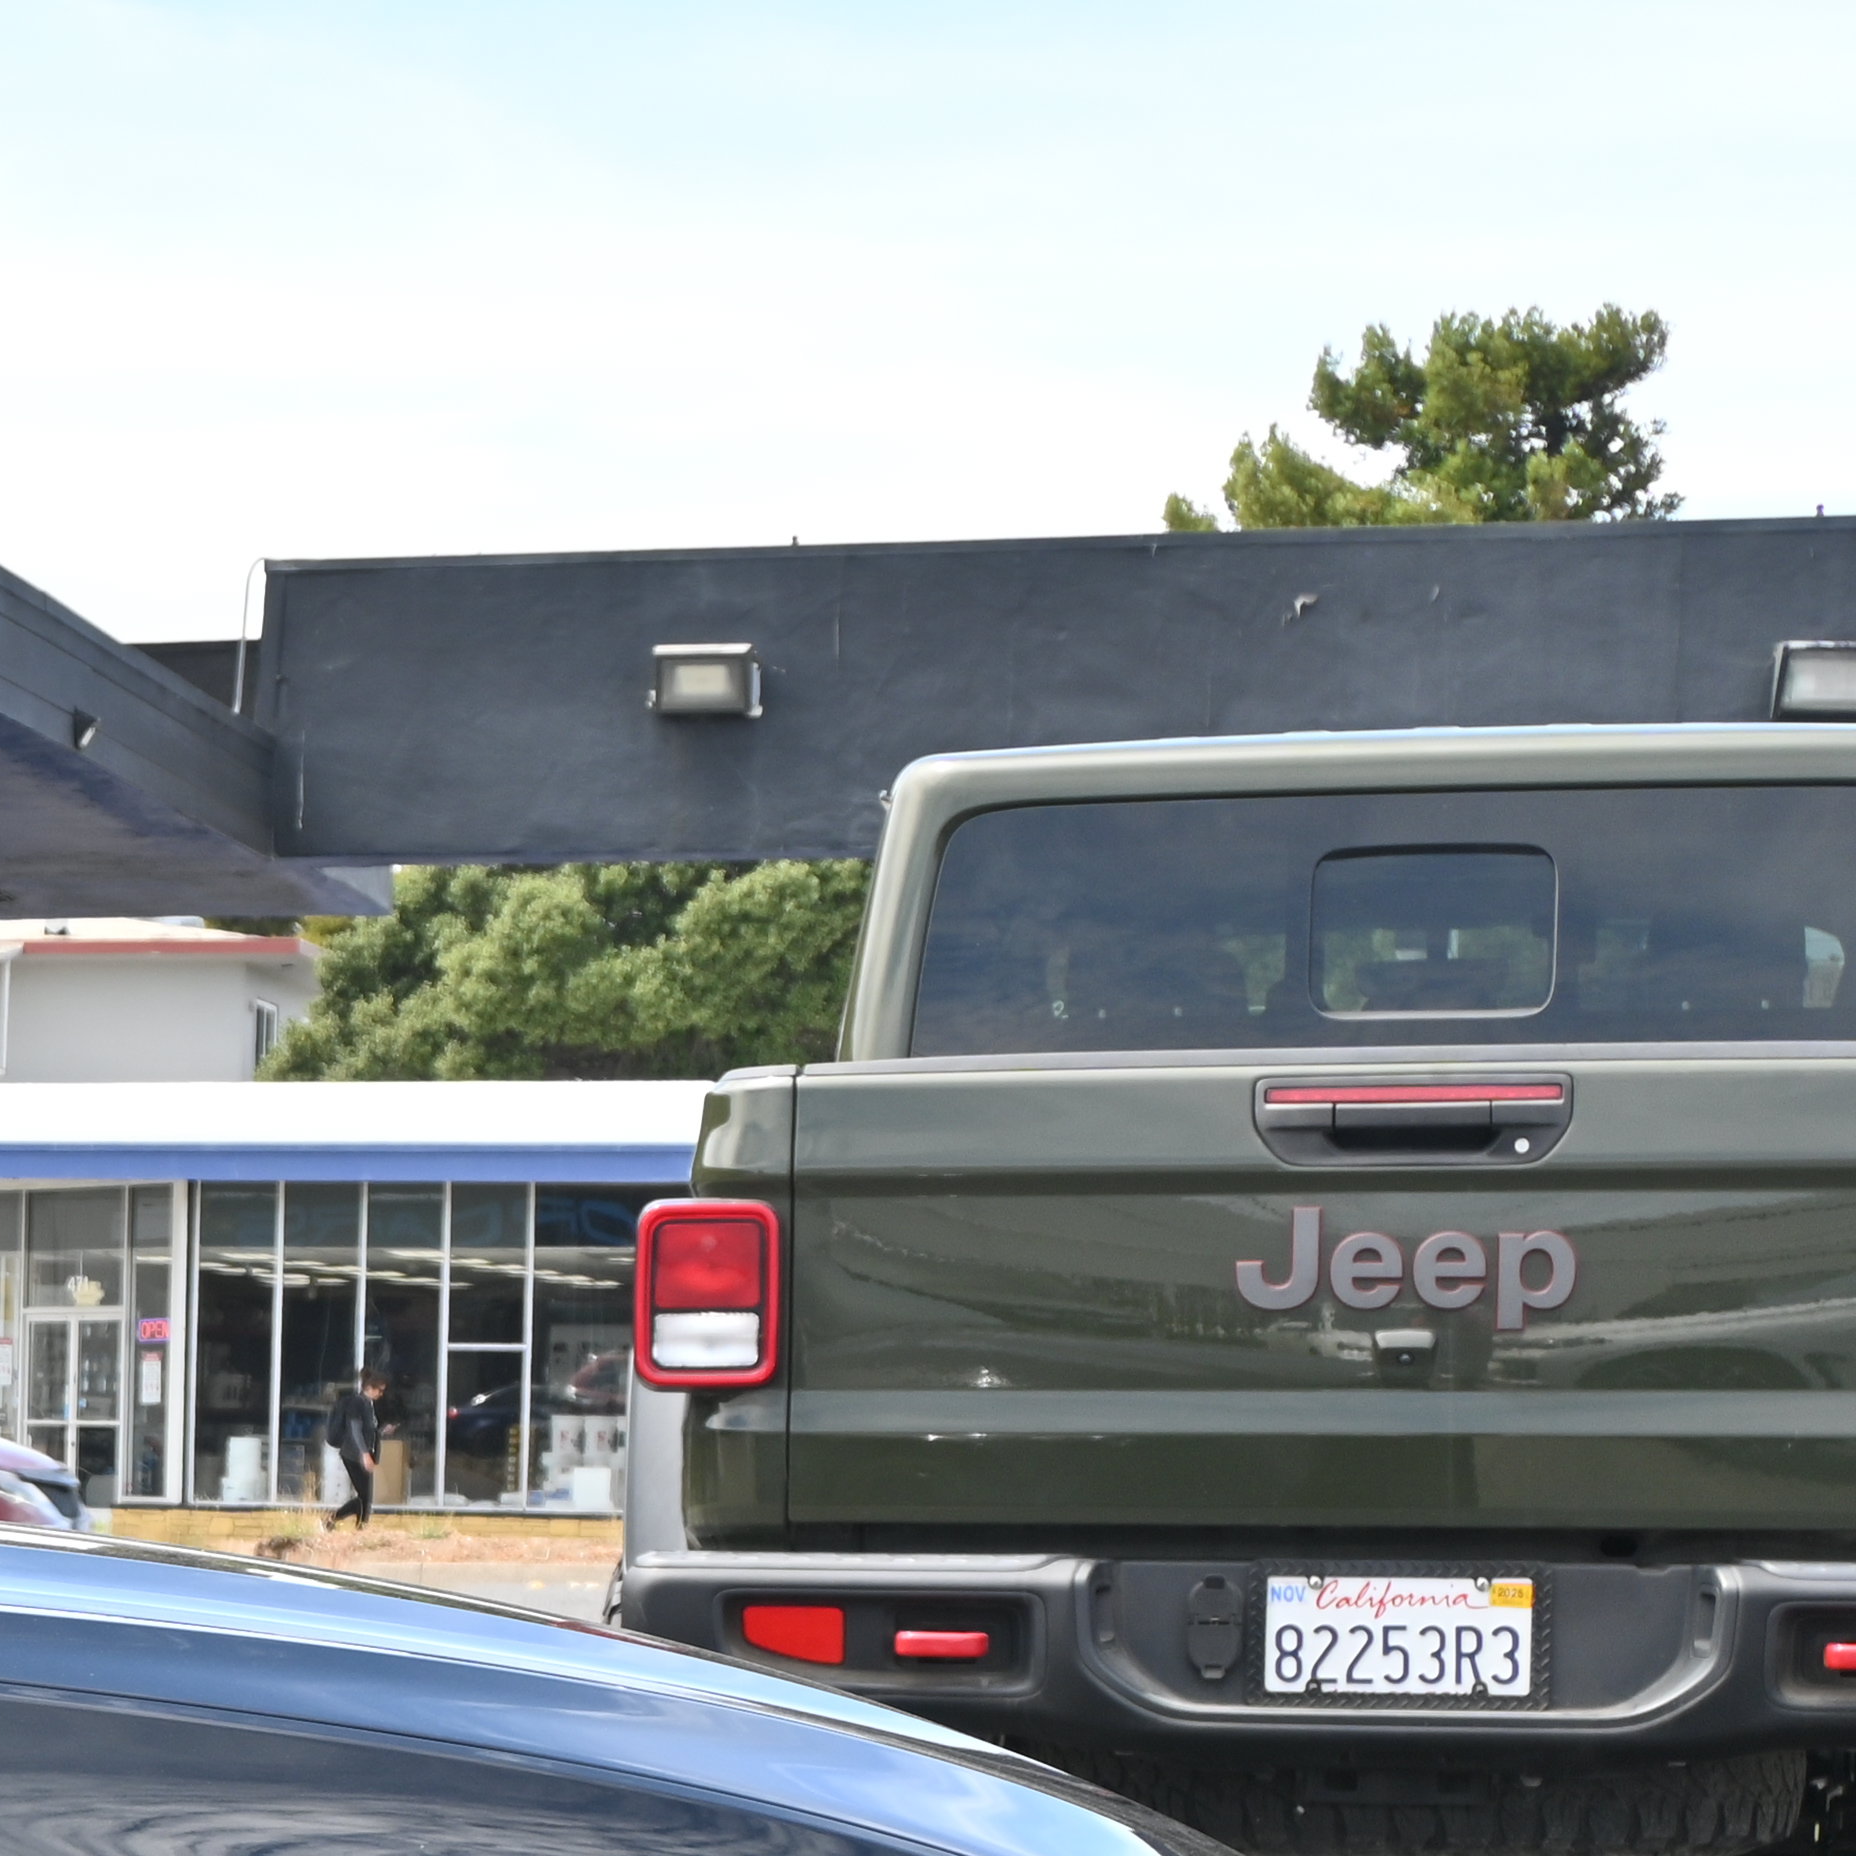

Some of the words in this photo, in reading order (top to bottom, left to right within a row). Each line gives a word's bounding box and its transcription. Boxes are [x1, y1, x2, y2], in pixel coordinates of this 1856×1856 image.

[1236, 1206, 1577, 1331] Jeep
[141, 1320, 168, 1340] OPEN
[1270, 1585, 1306, 1602] NOV
[1316, 1580, 1490, 1619] California
[1275, 1624, 1520, 1685] 82253R3
